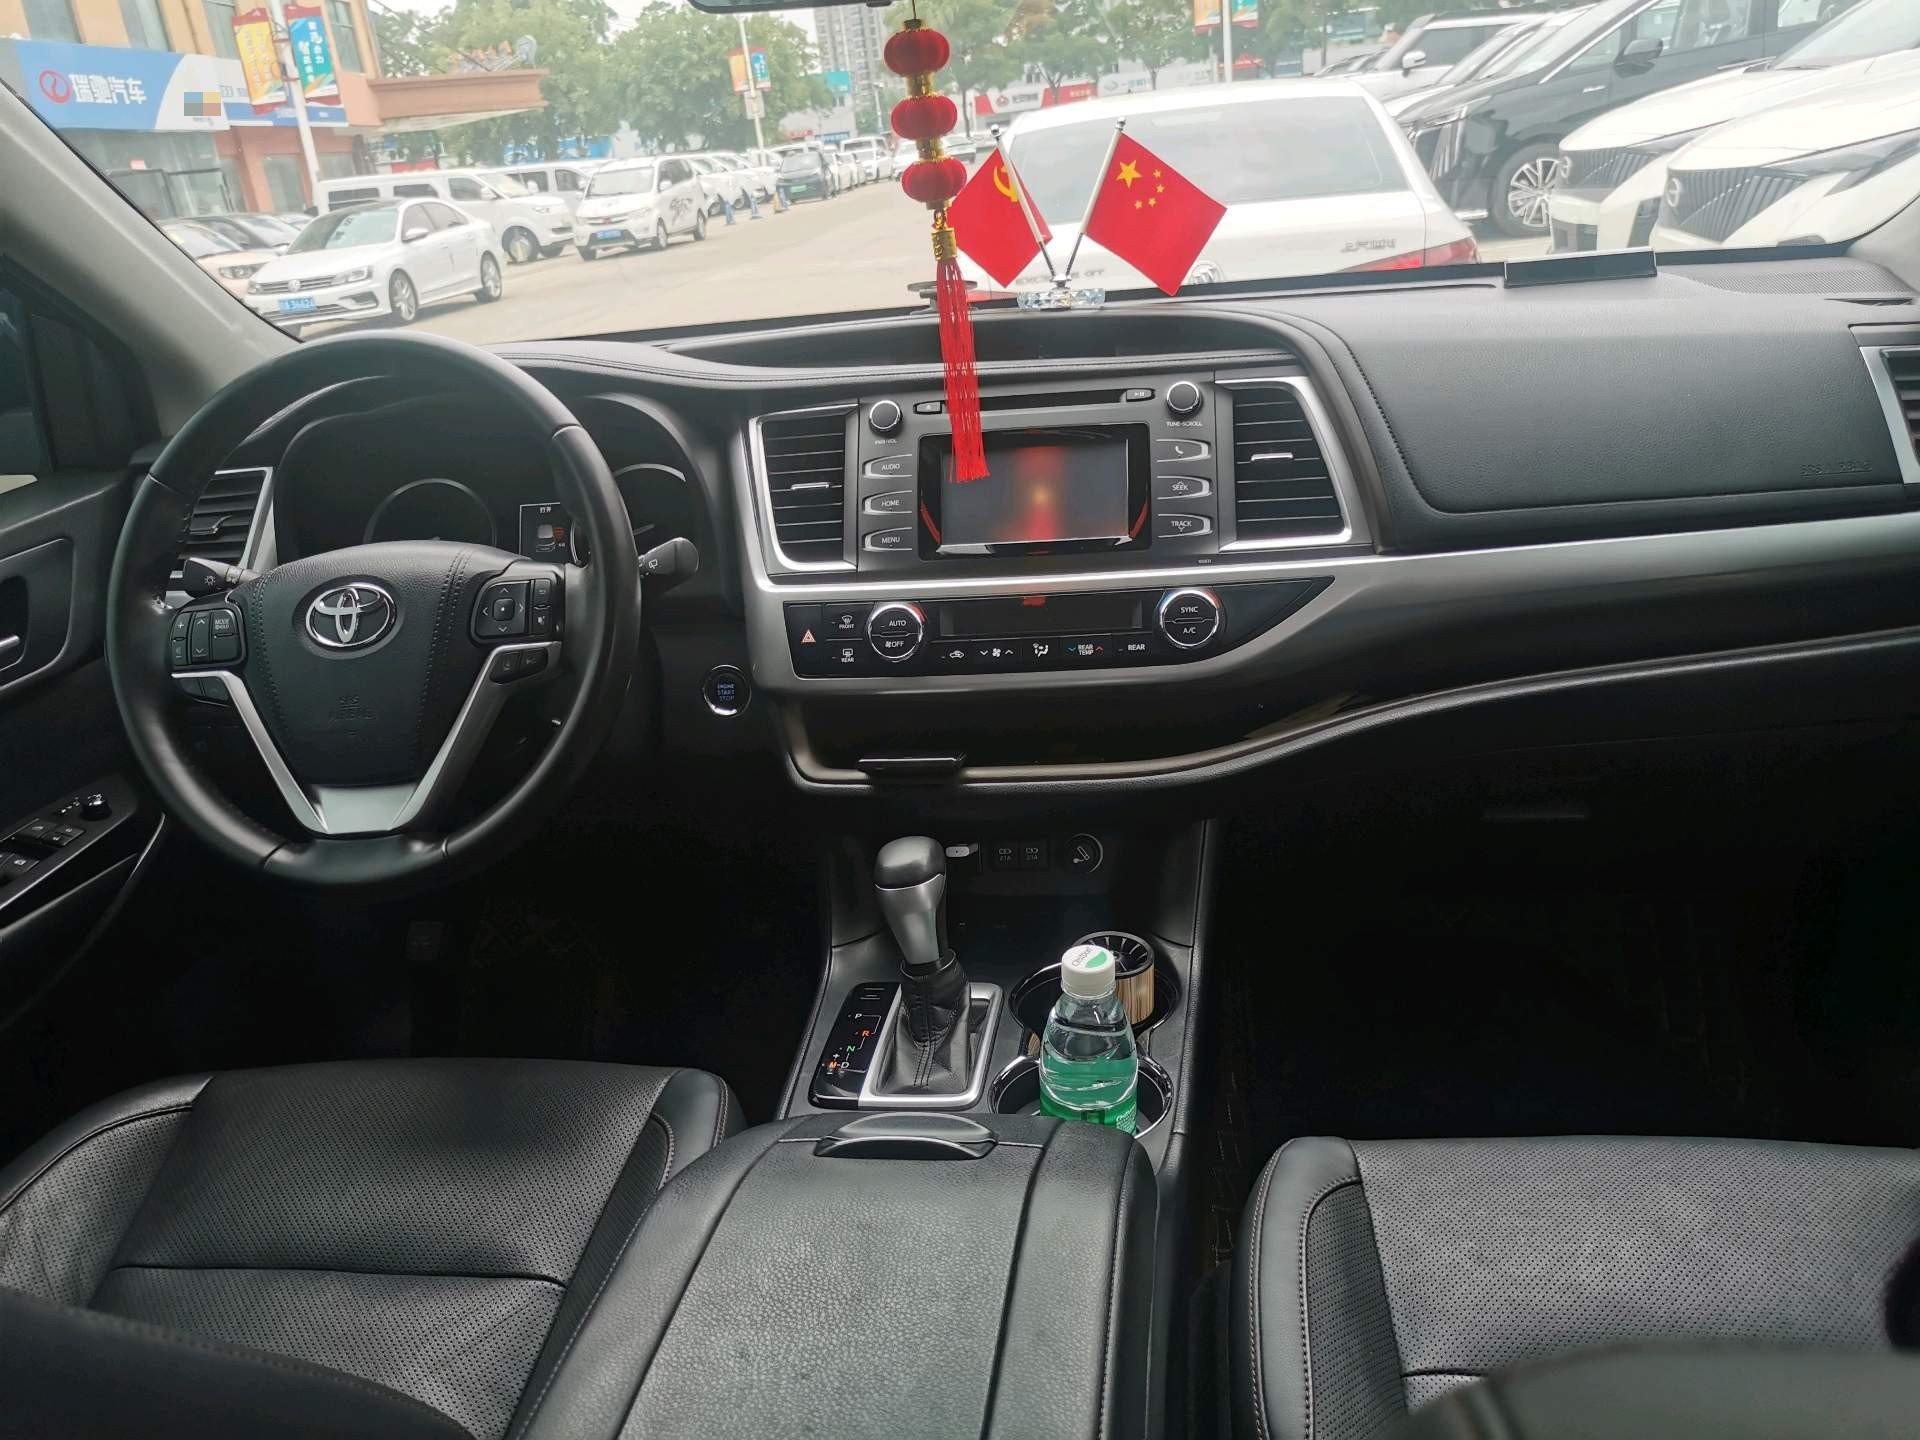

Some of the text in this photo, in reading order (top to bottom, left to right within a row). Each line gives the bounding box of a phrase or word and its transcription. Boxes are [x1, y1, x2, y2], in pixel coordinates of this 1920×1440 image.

[881, 463, 901, 471] AUDIO
[881, 499, 900, 507] HOME
[881, 536, 901, 544] MENU
[1182, 626, 1197, 634] A/C
[1127, 643, 1146, 651] REAR
[841, 1061, 850, 1069] D
